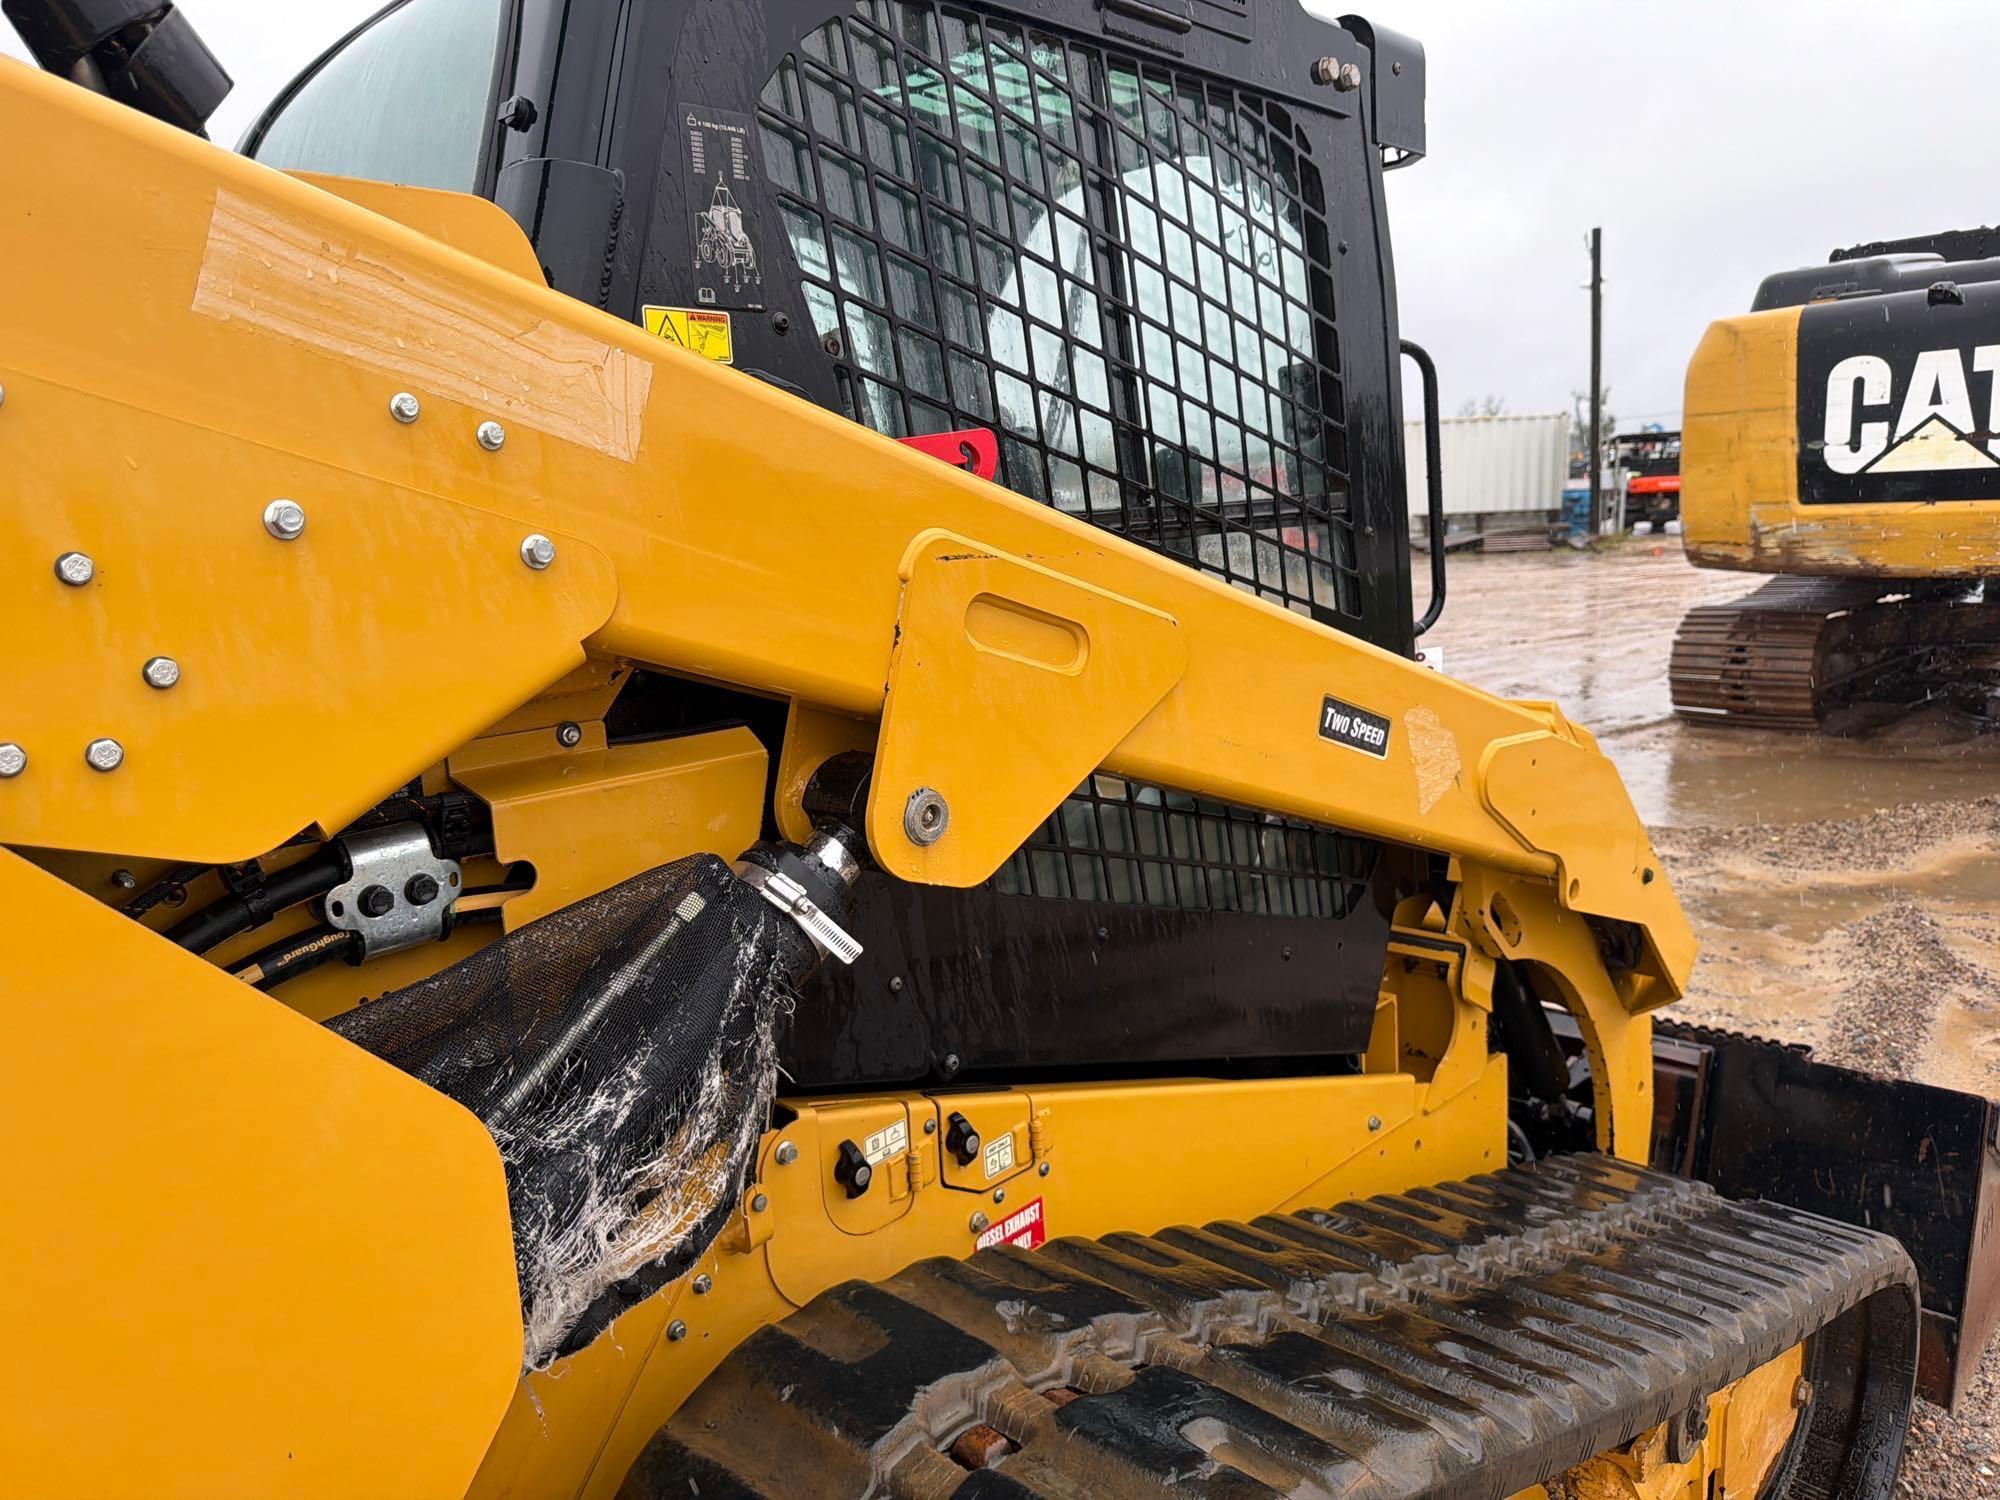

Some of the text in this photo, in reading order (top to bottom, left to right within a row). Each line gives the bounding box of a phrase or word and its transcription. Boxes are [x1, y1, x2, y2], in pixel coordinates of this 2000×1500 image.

[697, 314, 726, 323] WARNING
[976, 1202, 1040, 1251] DIESEL EXHAUST
